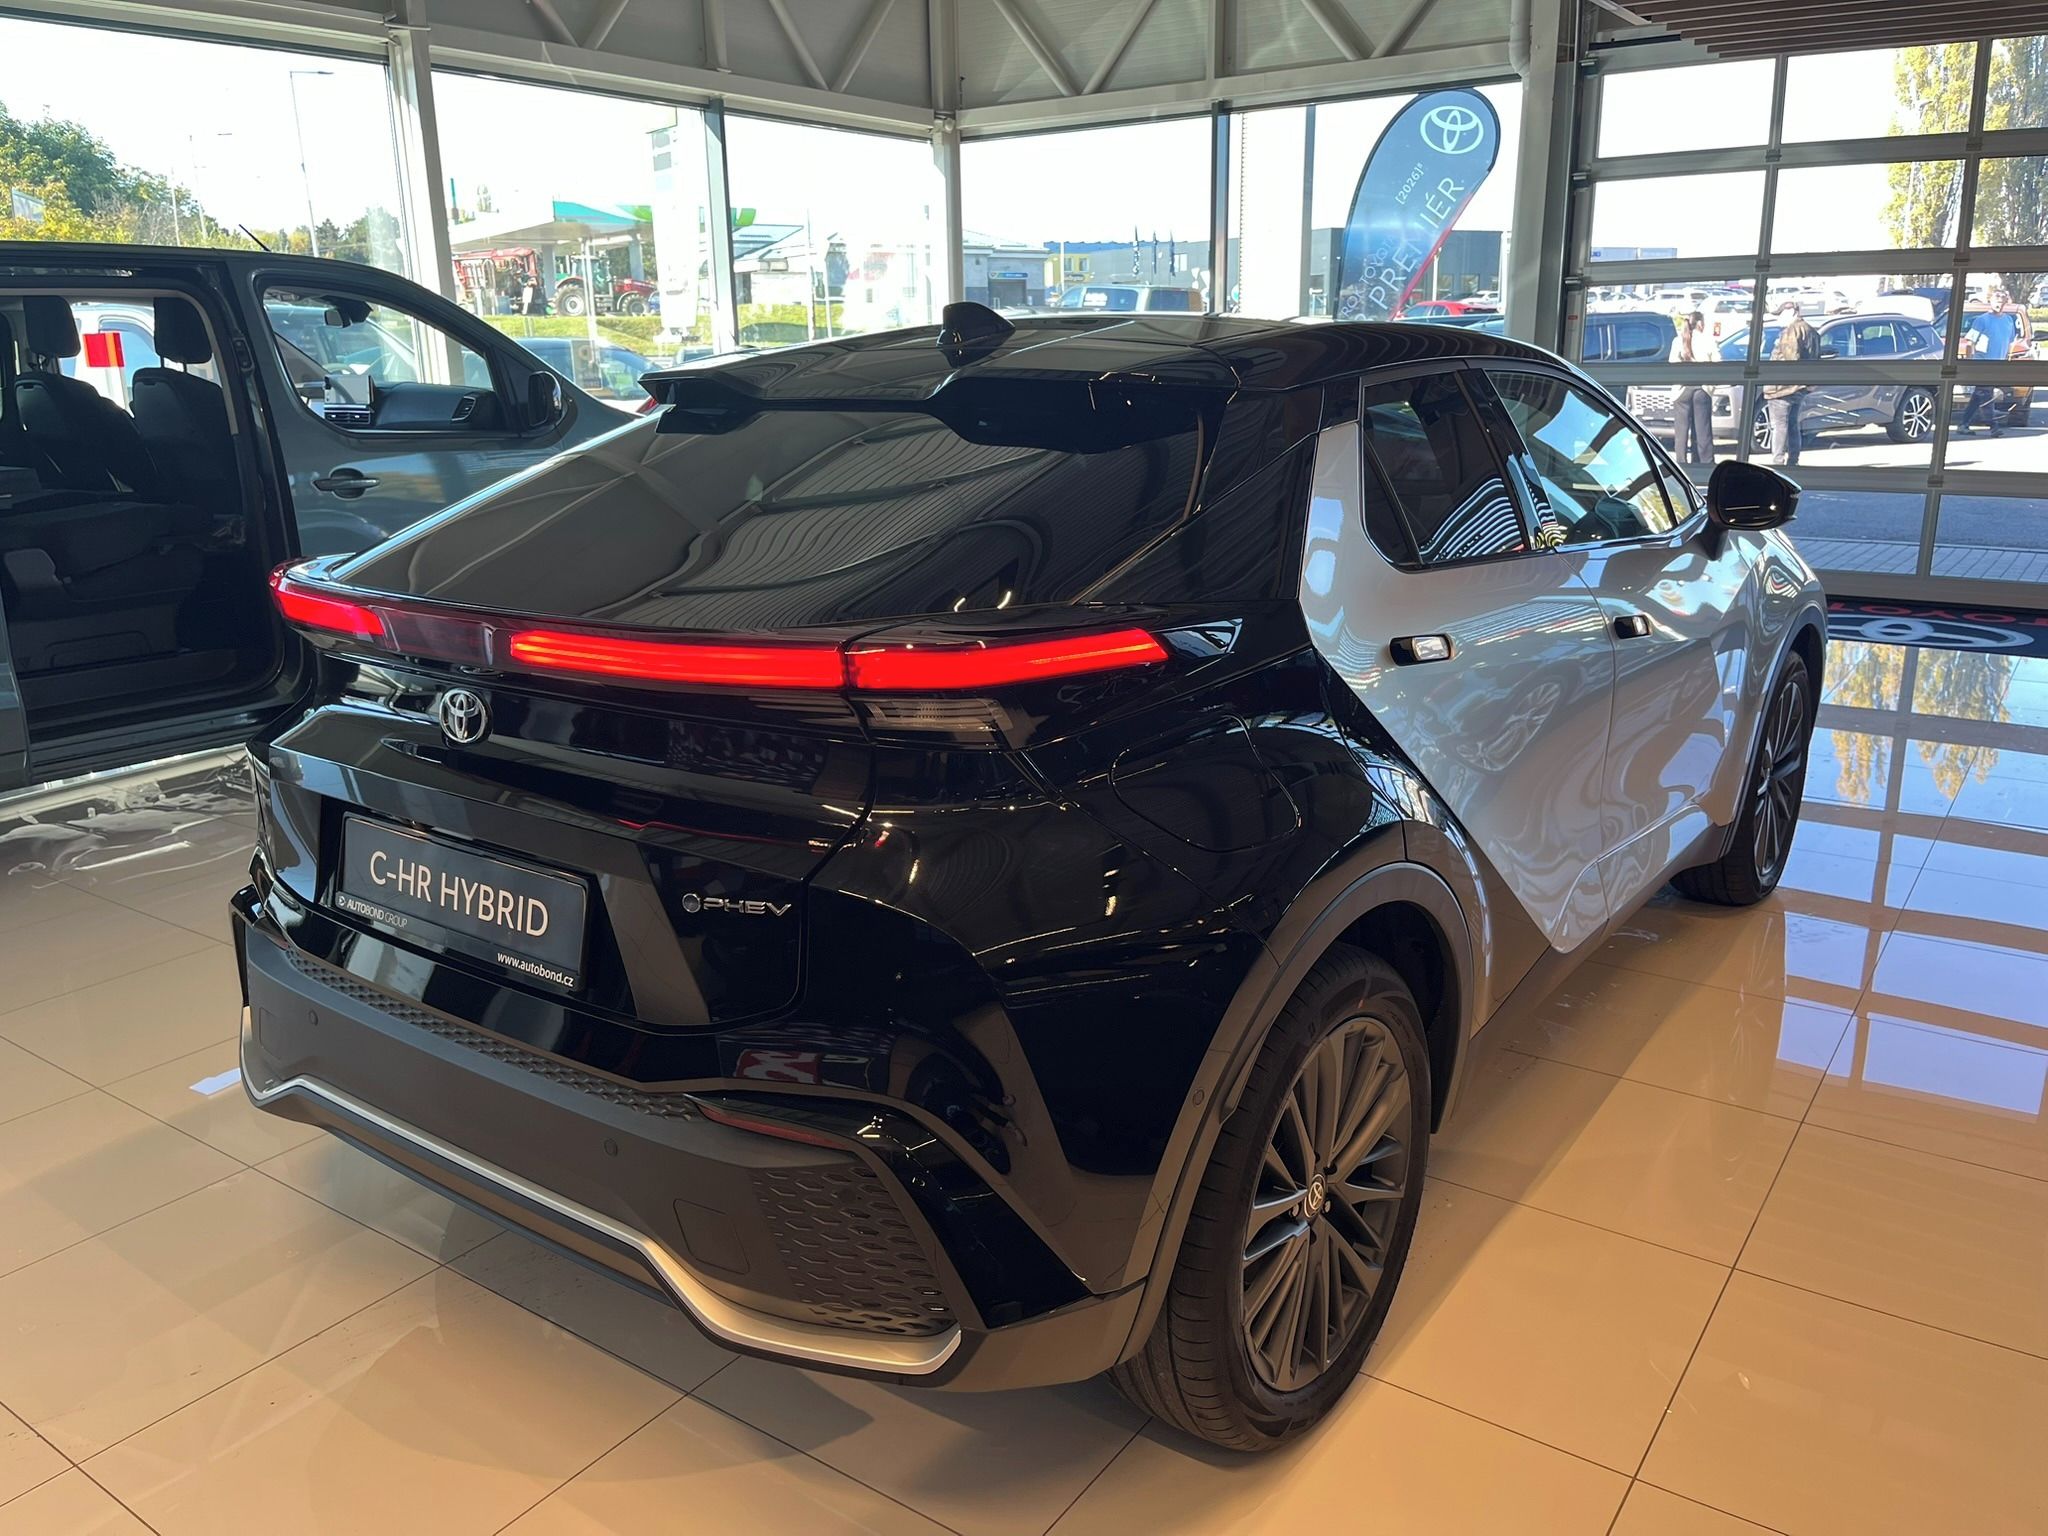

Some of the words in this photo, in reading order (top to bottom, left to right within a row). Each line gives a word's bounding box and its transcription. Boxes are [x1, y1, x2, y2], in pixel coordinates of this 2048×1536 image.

[1827, 602, 2048, 627] TOYOT
[369, 850, 432, 903] C-HR
[440, 872, 549, 938] HYBRID
[703, 897, 792, 917] PHEV
[346, 898, 385, 920] AUTOBOND
[385, 912, 408, 929] GROUP
[497, 952, 574, 988] www.autobond.cz
